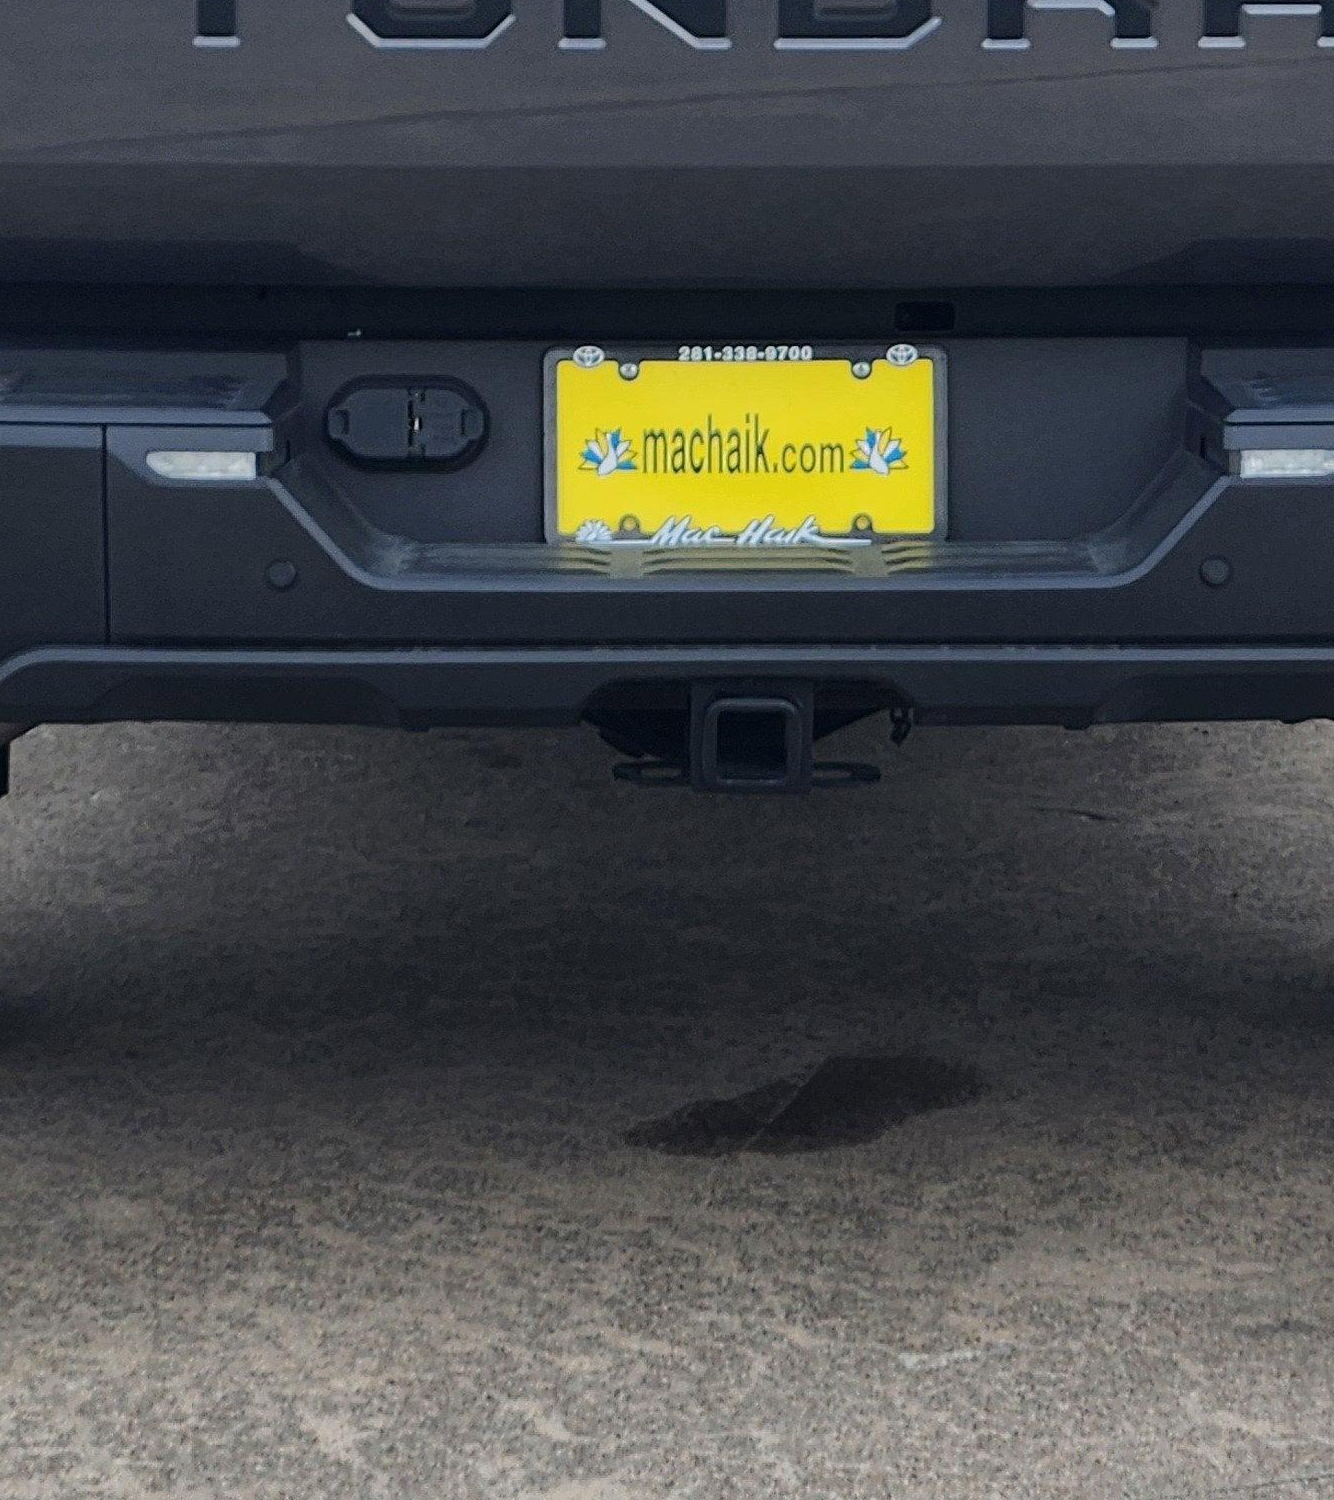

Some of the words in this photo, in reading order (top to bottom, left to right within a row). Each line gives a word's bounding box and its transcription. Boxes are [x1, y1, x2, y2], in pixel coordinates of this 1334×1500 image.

[641, 413, 846, 474] machaik.com
[649, 514, 736, 547] Mac
[735, 513, 872, 548] Haik
